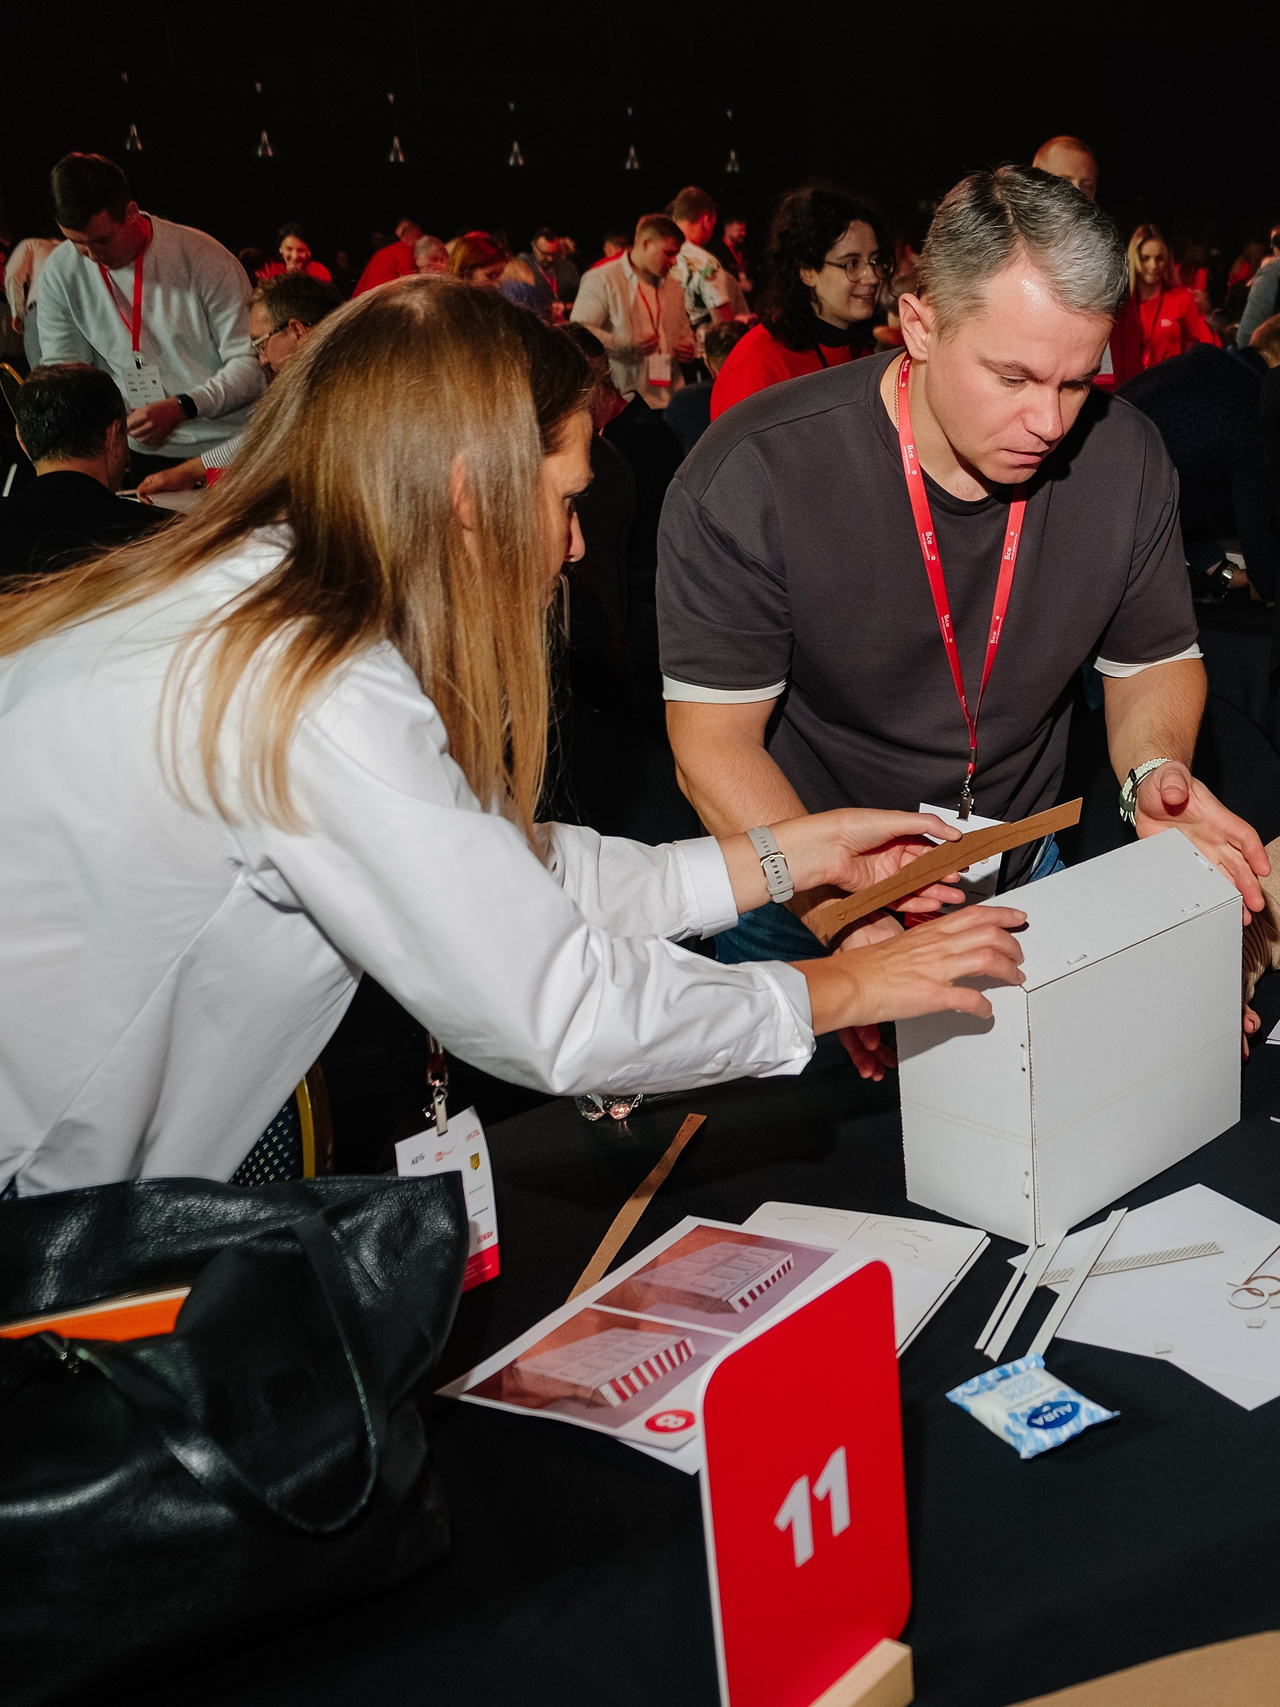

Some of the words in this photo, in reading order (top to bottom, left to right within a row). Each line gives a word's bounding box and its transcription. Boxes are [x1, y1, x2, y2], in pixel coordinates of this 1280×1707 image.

[925, 531, 933, 545] Все
[1004, 547, 1012, 560] Все
[1030, 1403, 1073, 1426] AURA
[773, 1445, 851, 1568] 11
